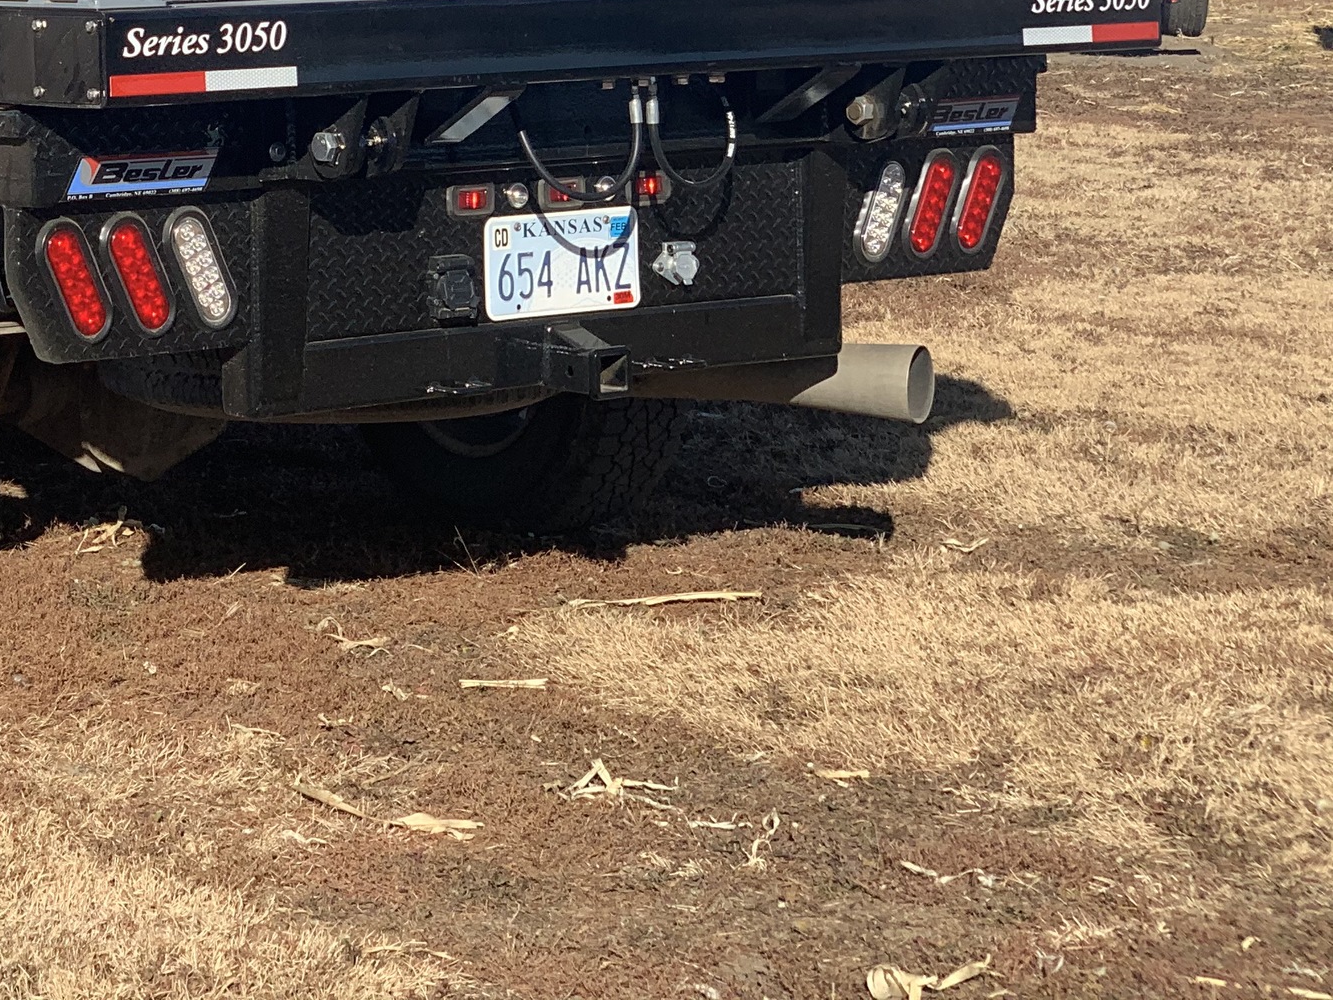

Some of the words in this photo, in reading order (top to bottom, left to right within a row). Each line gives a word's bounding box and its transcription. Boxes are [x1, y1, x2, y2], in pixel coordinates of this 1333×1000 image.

[122, 25, 210, 58] Series
[216, 20, 288, 55] 3050
[930, 102, 1009, 123] Besler
[91, 158, 204, 185] Besler
[494, 227, 509, 248] CD
[521, 216, 603, 239] KANSAS
[610, 221, 627, 232] FEB
[498, 250, 554, 302] 654
[575, 242, 632, 295] AKZ
